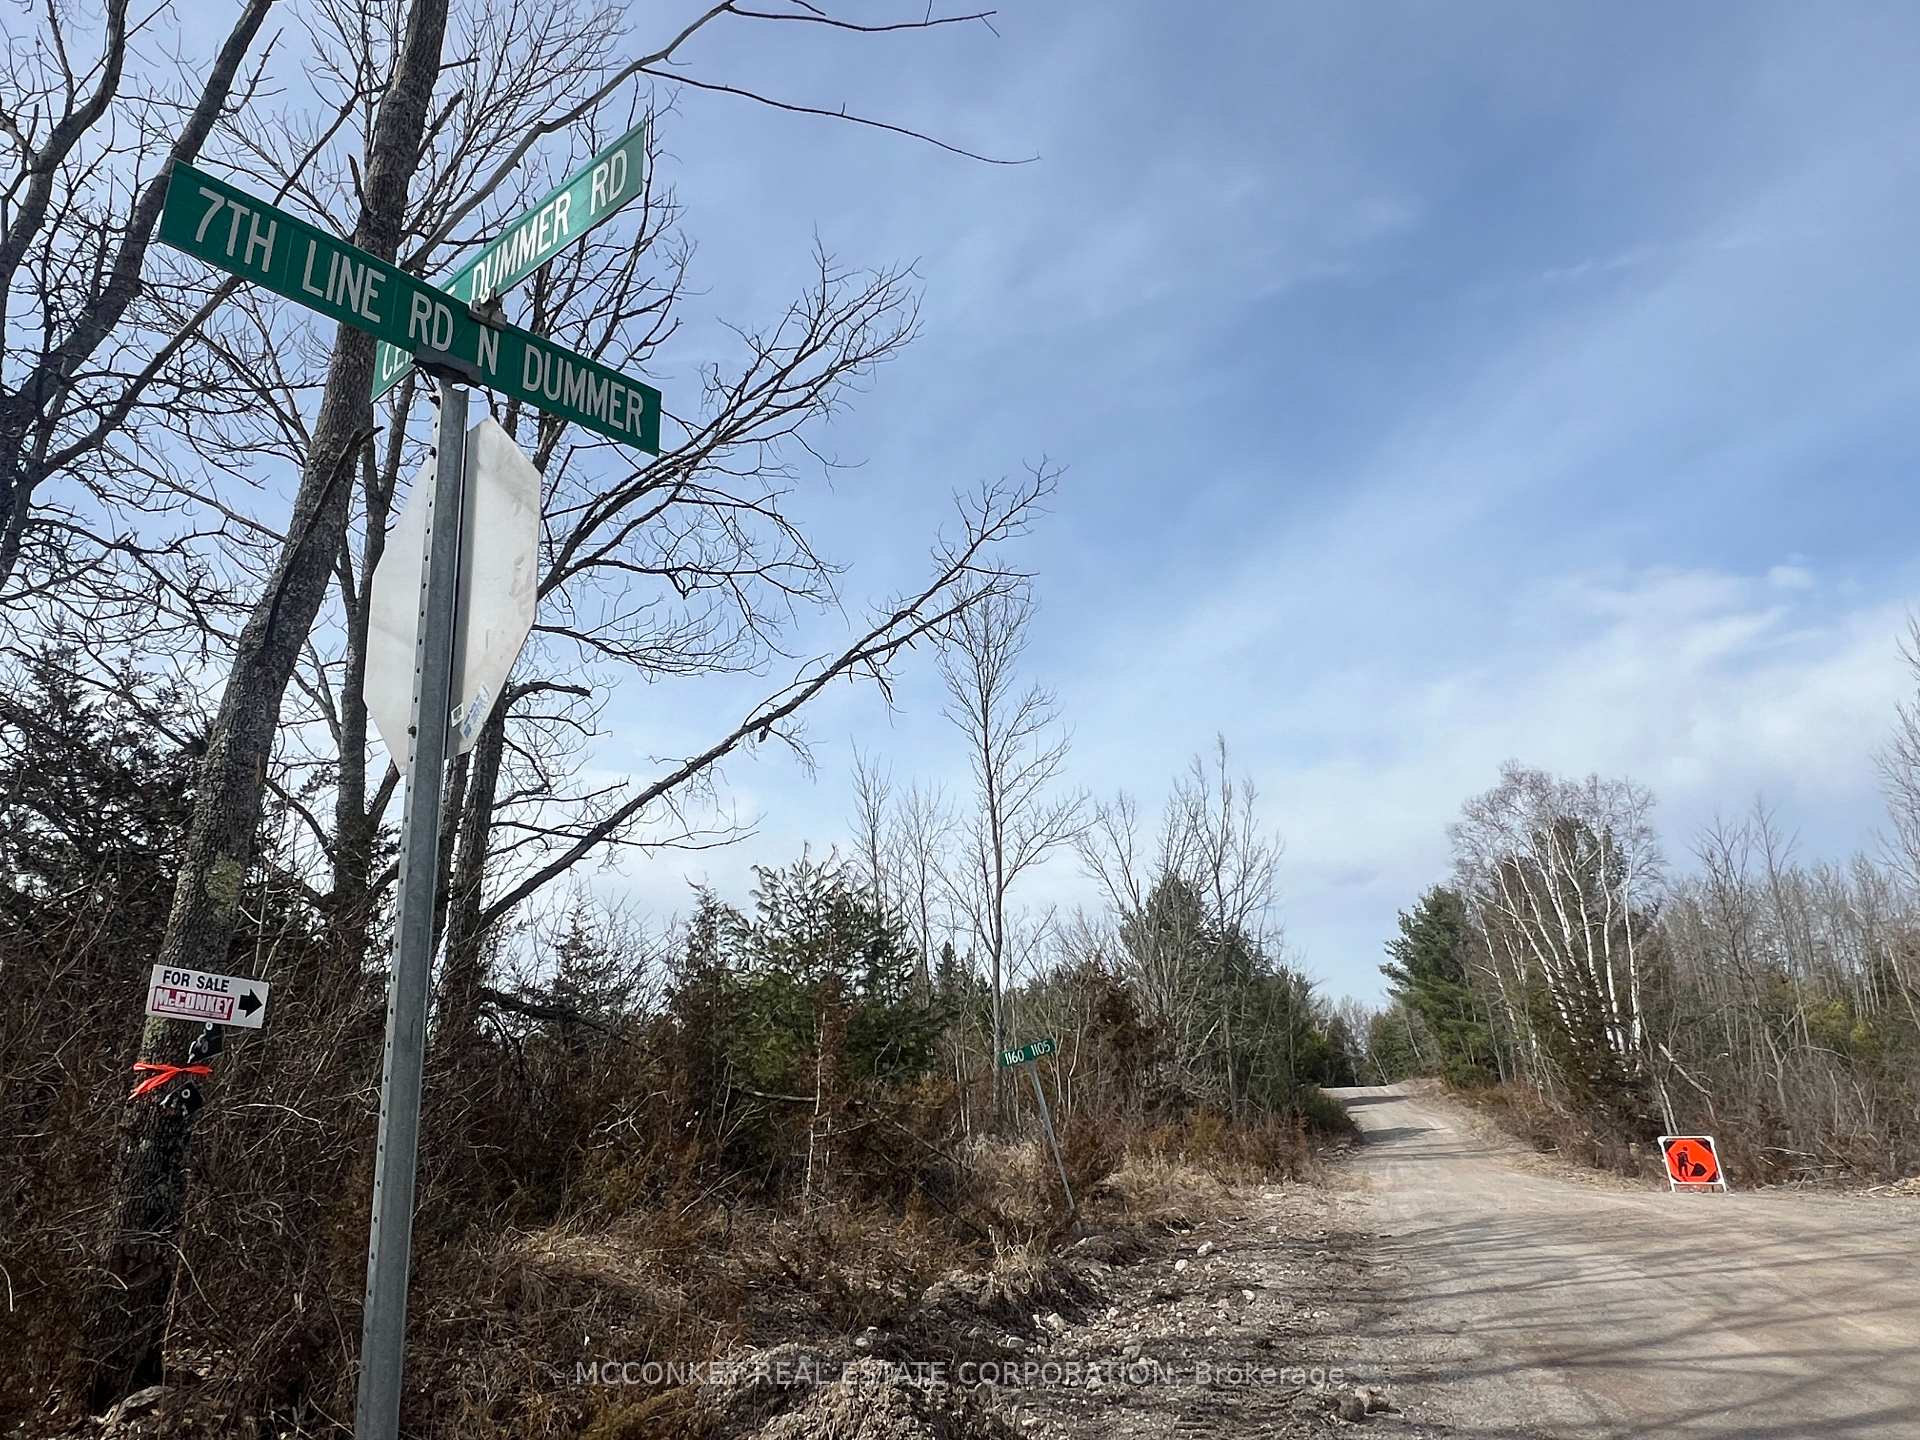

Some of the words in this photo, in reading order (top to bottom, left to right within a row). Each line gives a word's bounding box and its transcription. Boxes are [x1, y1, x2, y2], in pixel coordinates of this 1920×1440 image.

[470, 191, 573, 308] DUMMER
[590, 149, 628, 216] RD
[195, 187, 278, 273] 7TH
[302, 240, 387, 324] LINE
[408, 290, 454, 352] RD
[477, 324, 499, 376] N
[522, 343, 644, 438] DUMMER
[162, 969, 191, 987] FOR
[196, 975, 230, 993] SALE
[1004, 1049, 1025, 1066] 1160
[1030, 1040, 1051, 1057] 1105
